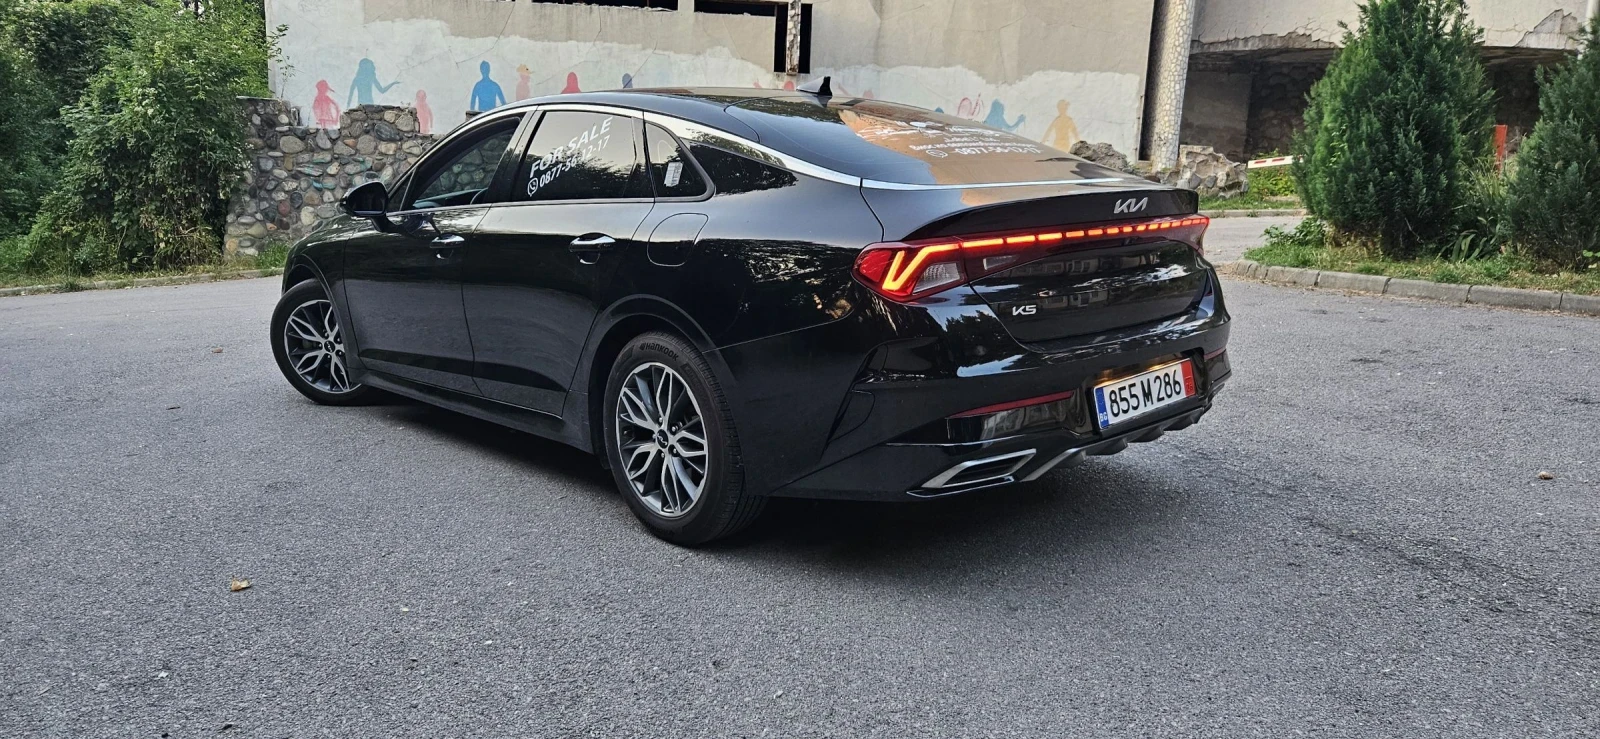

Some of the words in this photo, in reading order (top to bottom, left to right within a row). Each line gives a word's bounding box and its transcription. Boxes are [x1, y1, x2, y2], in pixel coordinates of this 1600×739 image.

[530, 146, 564, 179] FOR
[566, 116, 613, 155] SALE
[540, 135, 611, 187] 0877-56-12-17
[1012, 304, 1037, 316] K5
[1099, 411, 1108, 421] BG
[1109, 382, 1140, 418] 855
[1140, 378, 1154, 408] M
[1153, 369, 1182, 402] 286
